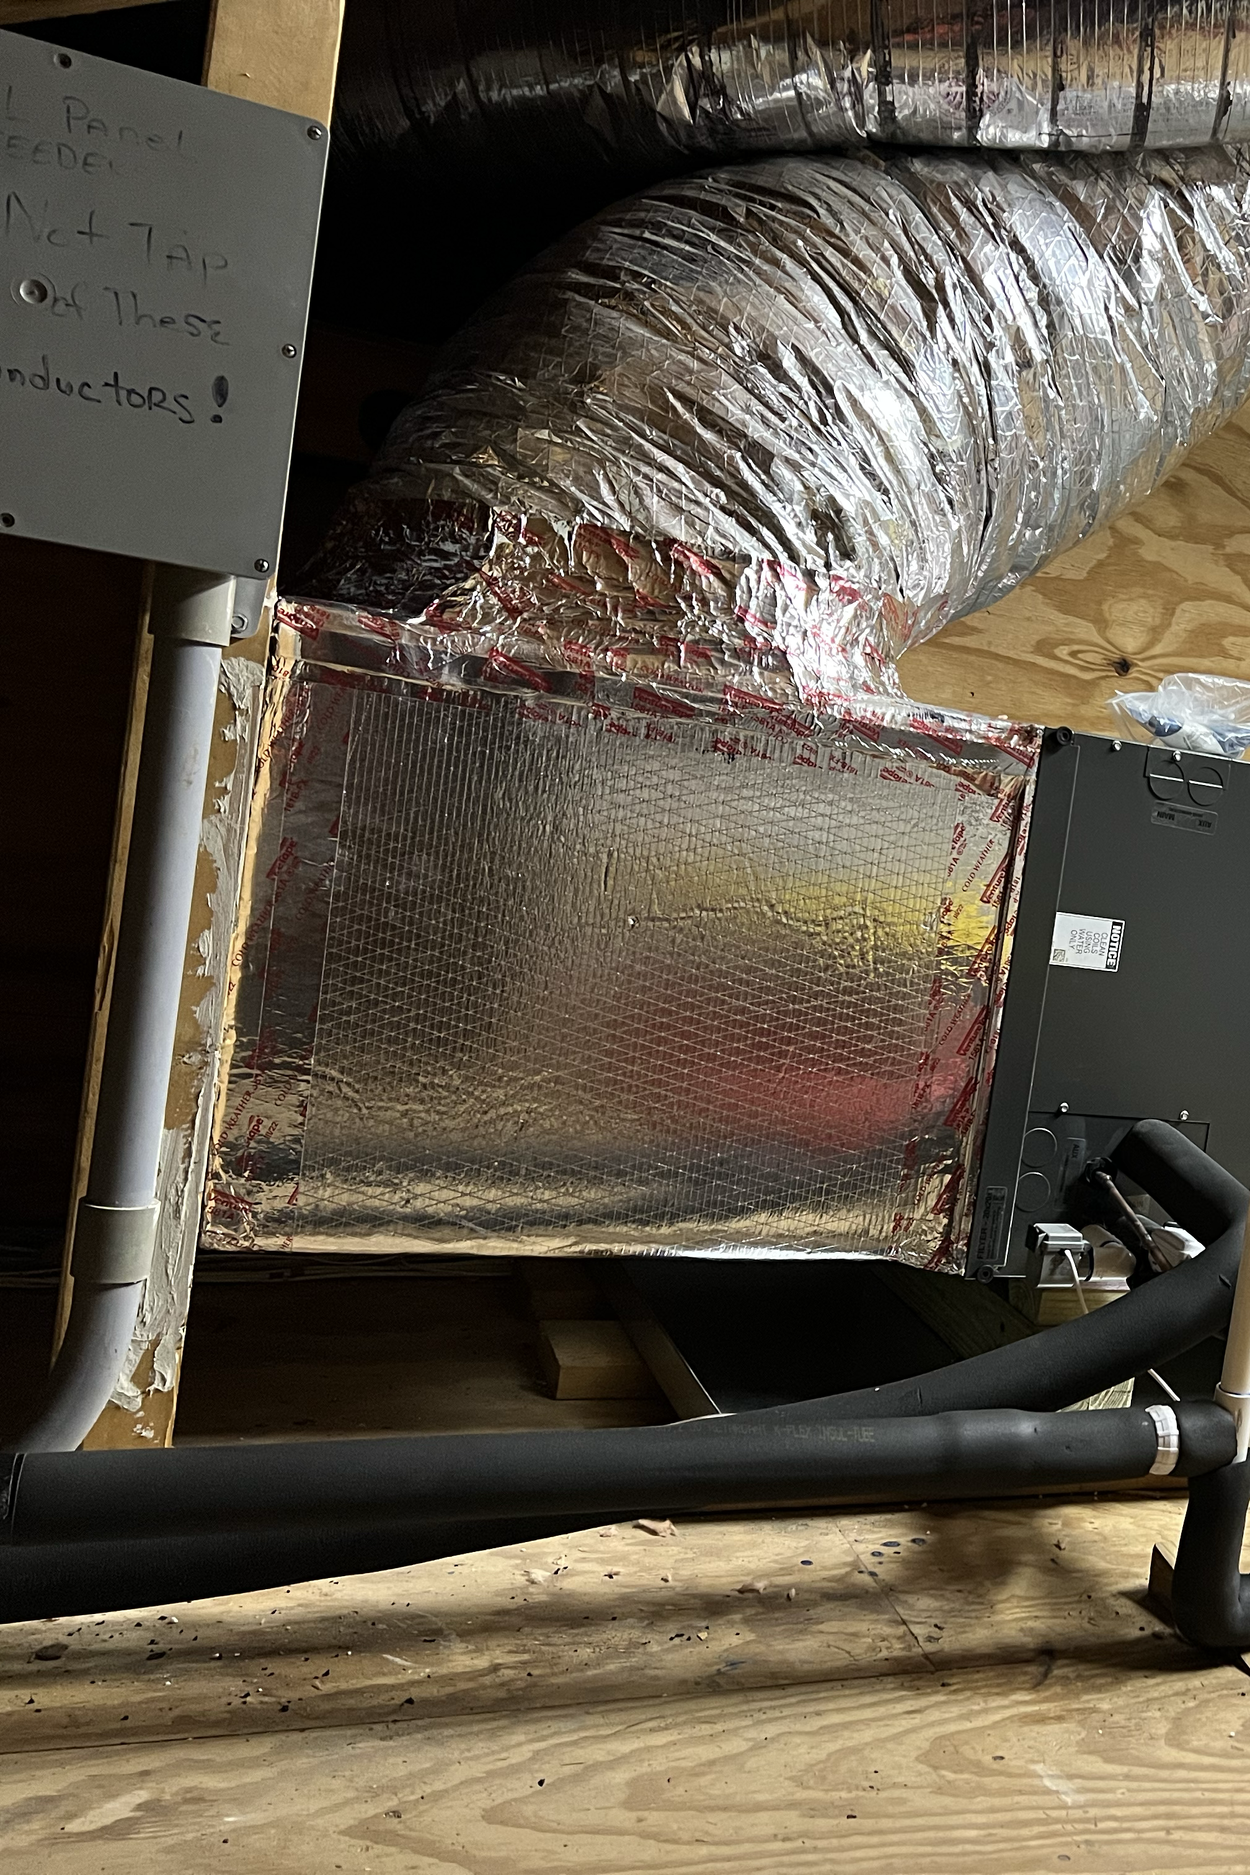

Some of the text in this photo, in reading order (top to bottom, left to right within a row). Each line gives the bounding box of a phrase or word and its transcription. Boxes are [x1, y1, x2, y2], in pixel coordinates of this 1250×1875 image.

[1069, 929, 1078, 950] ONLY
[1075, 928, 1086, 954] WATER
[1083, 931, 1093, 954] USING
[1091, 932, 1101, 954] COILS
[1099, 932, 1109, 956] CLEAN
[1107, 925, 1122, 968] NOTICE
